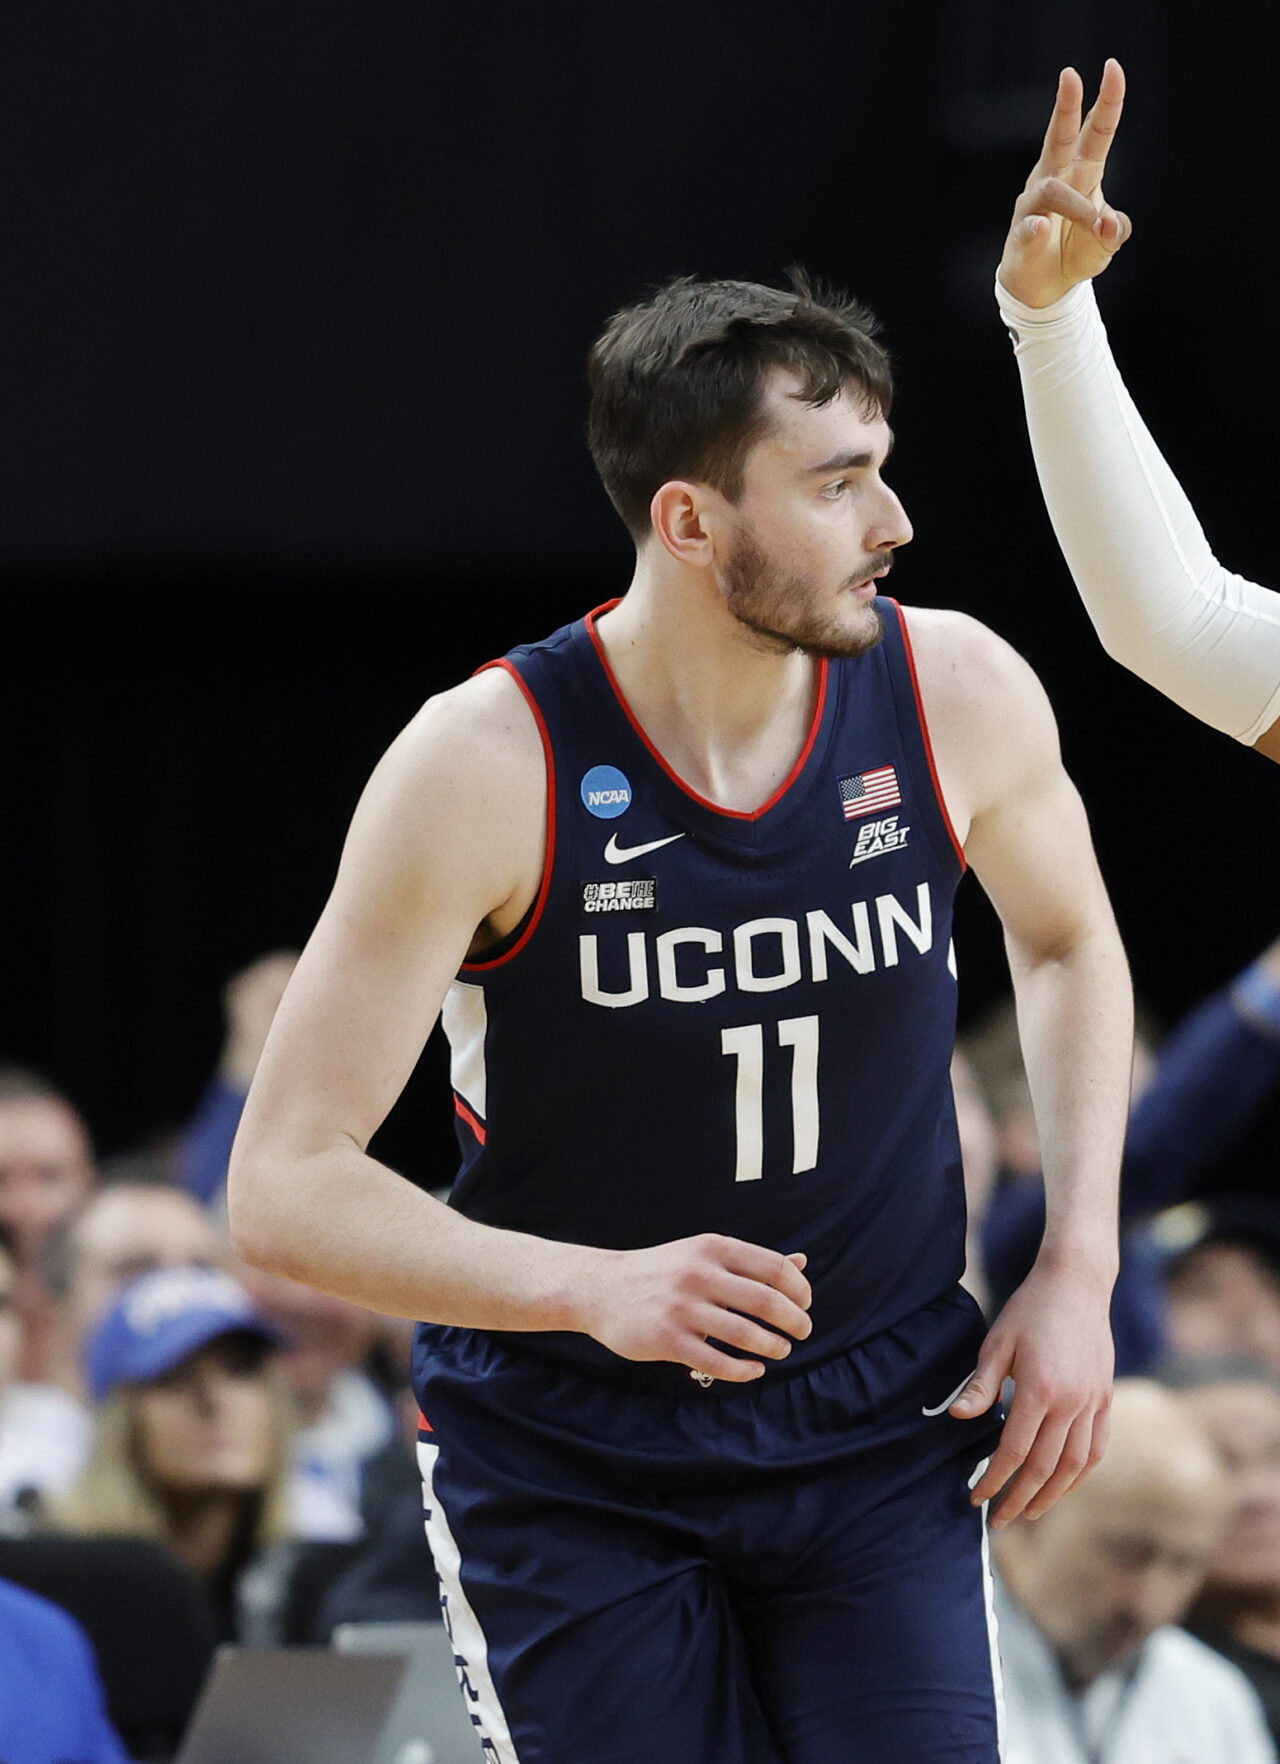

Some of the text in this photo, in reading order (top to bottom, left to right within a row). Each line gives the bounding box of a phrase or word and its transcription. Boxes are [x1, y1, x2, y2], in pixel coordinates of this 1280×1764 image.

[588, 789, 629, 806] NCAA
[853, 826, 911, 857] EAST
[857, 815, 899, 842] BIG
[584, 897, 655, 913] CHANGE
[579, 882, 932, 1009] UCONN
[721, 1014, 820, 1183] 11
